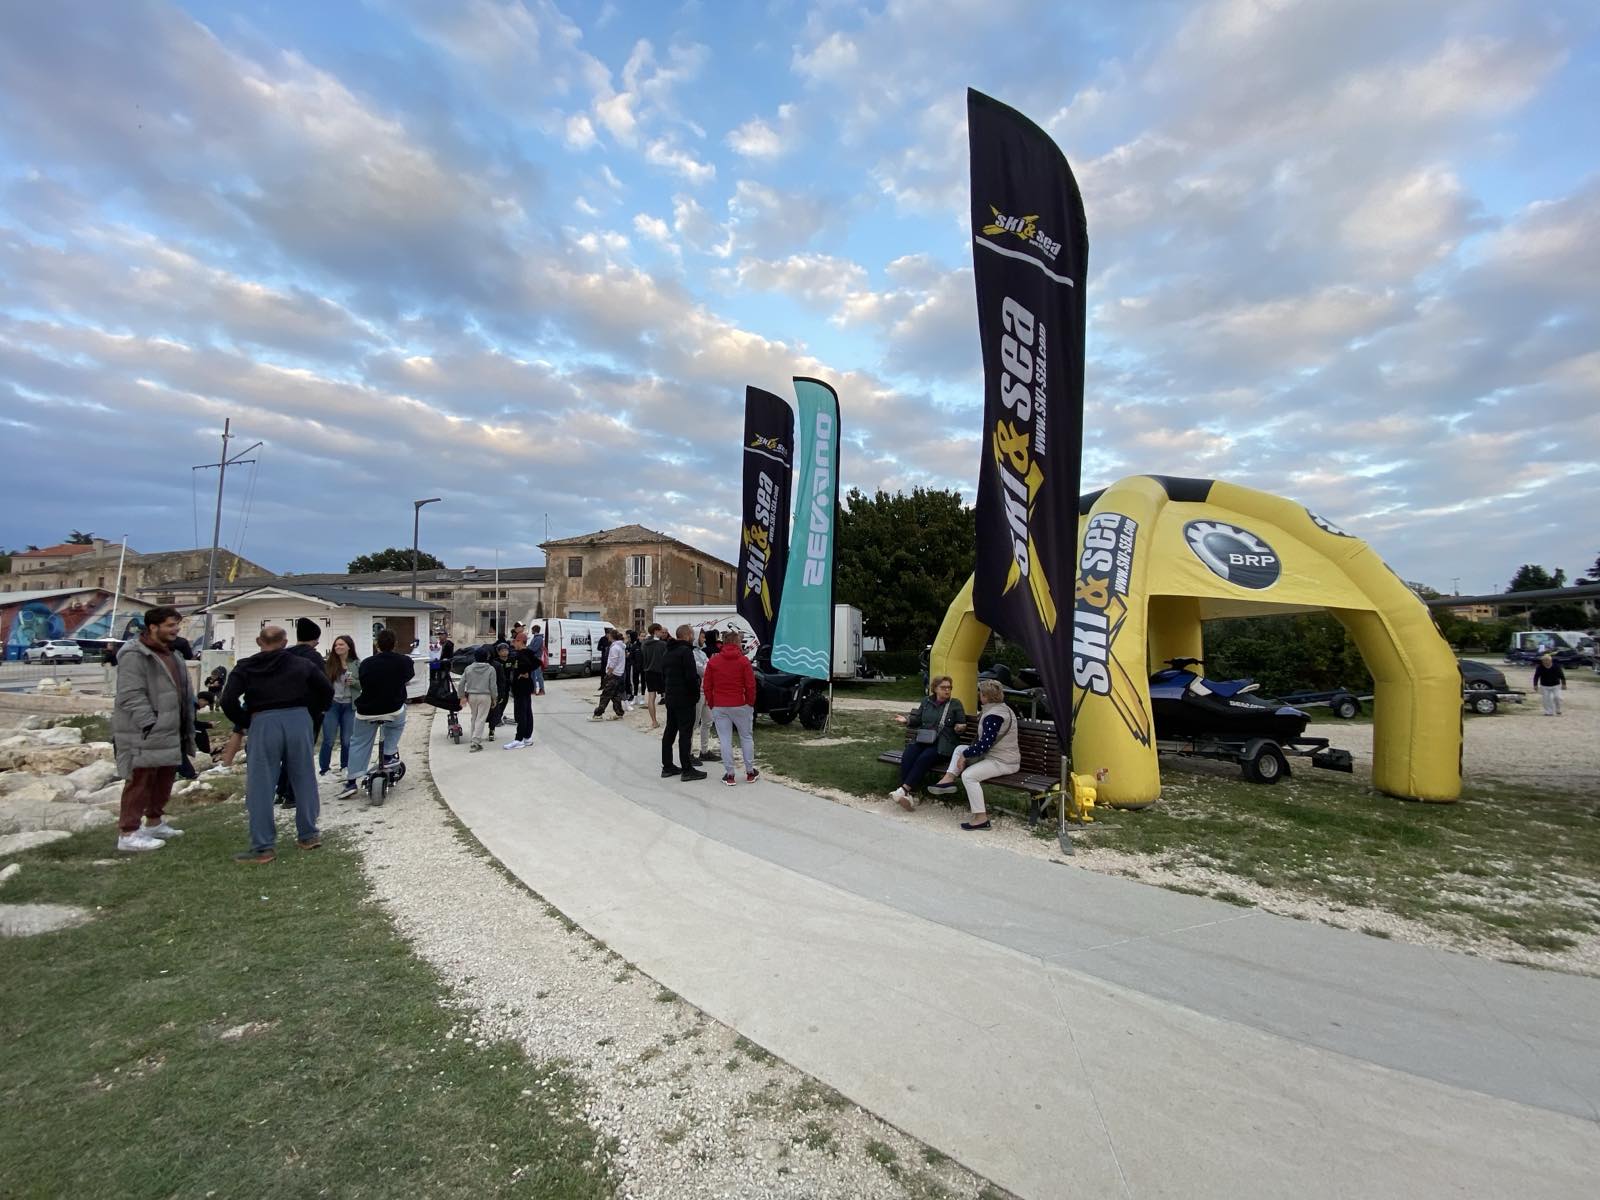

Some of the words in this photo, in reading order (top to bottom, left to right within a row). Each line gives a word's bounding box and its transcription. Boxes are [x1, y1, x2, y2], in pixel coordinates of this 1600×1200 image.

[1023, 223, 1037, 239] &
[997, 419, 1029, 474] &
[751, 524, 768, 550] &
[1229, 553, 1275, 567] BRP
[1075, 574, 1109, 611] &
